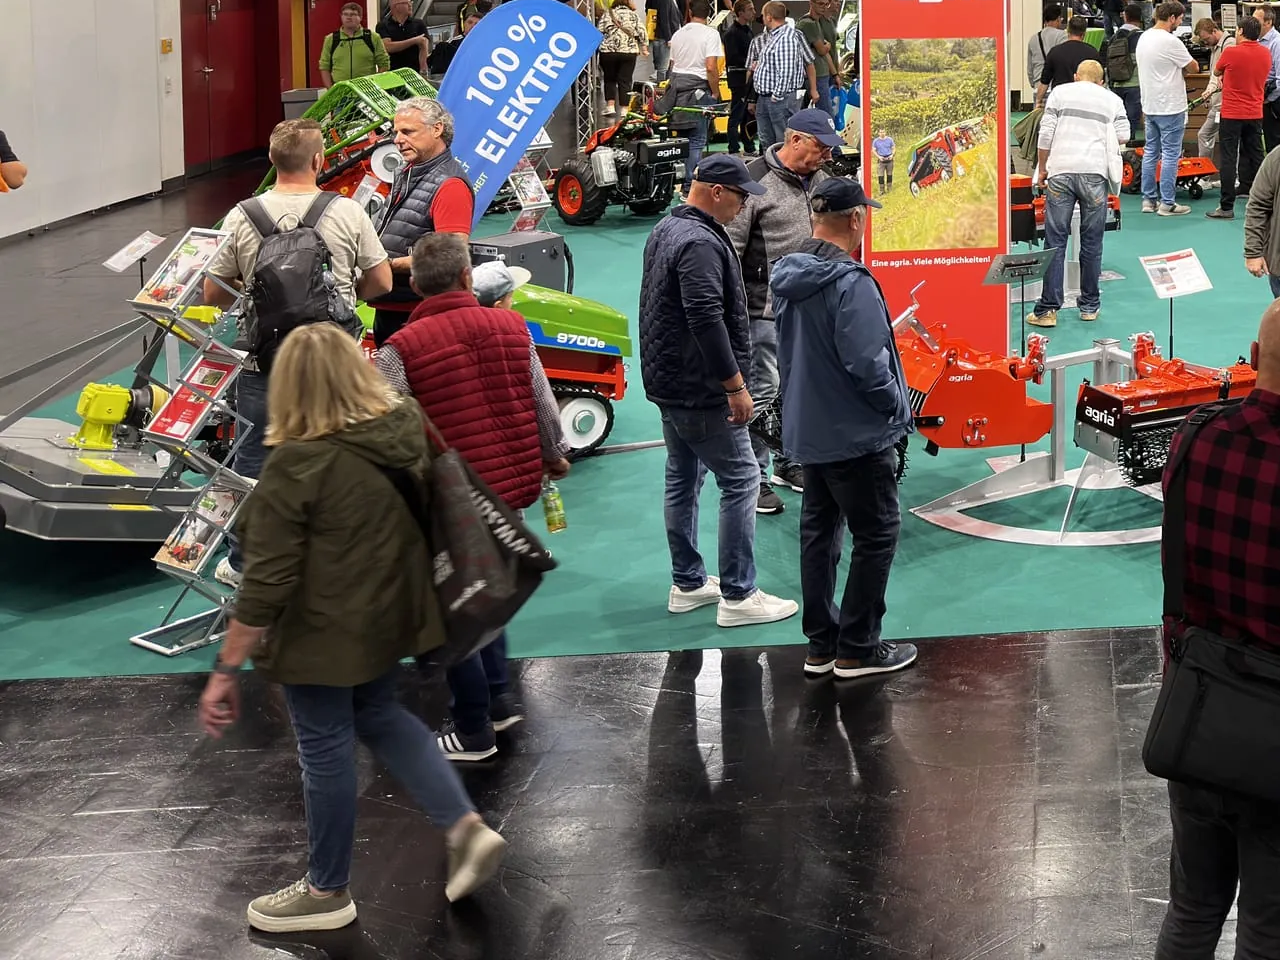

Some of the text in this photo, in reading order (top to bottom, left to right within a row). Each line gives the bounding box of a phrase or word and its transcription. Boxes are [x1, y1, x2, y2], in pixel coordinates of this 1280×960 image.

[466, 12, 547, 107] 100 %
[474, 31, 578, 165] ELEKTRO
[656, 146, 681, 157] agria
[871, 256, 991, 268] Eine agria. Viele Möglichkeiten!
[556, 332, 606, 349] 9700e
[948, 373, 974, 383] agria
[1085, 406, 1115, 427] agria
